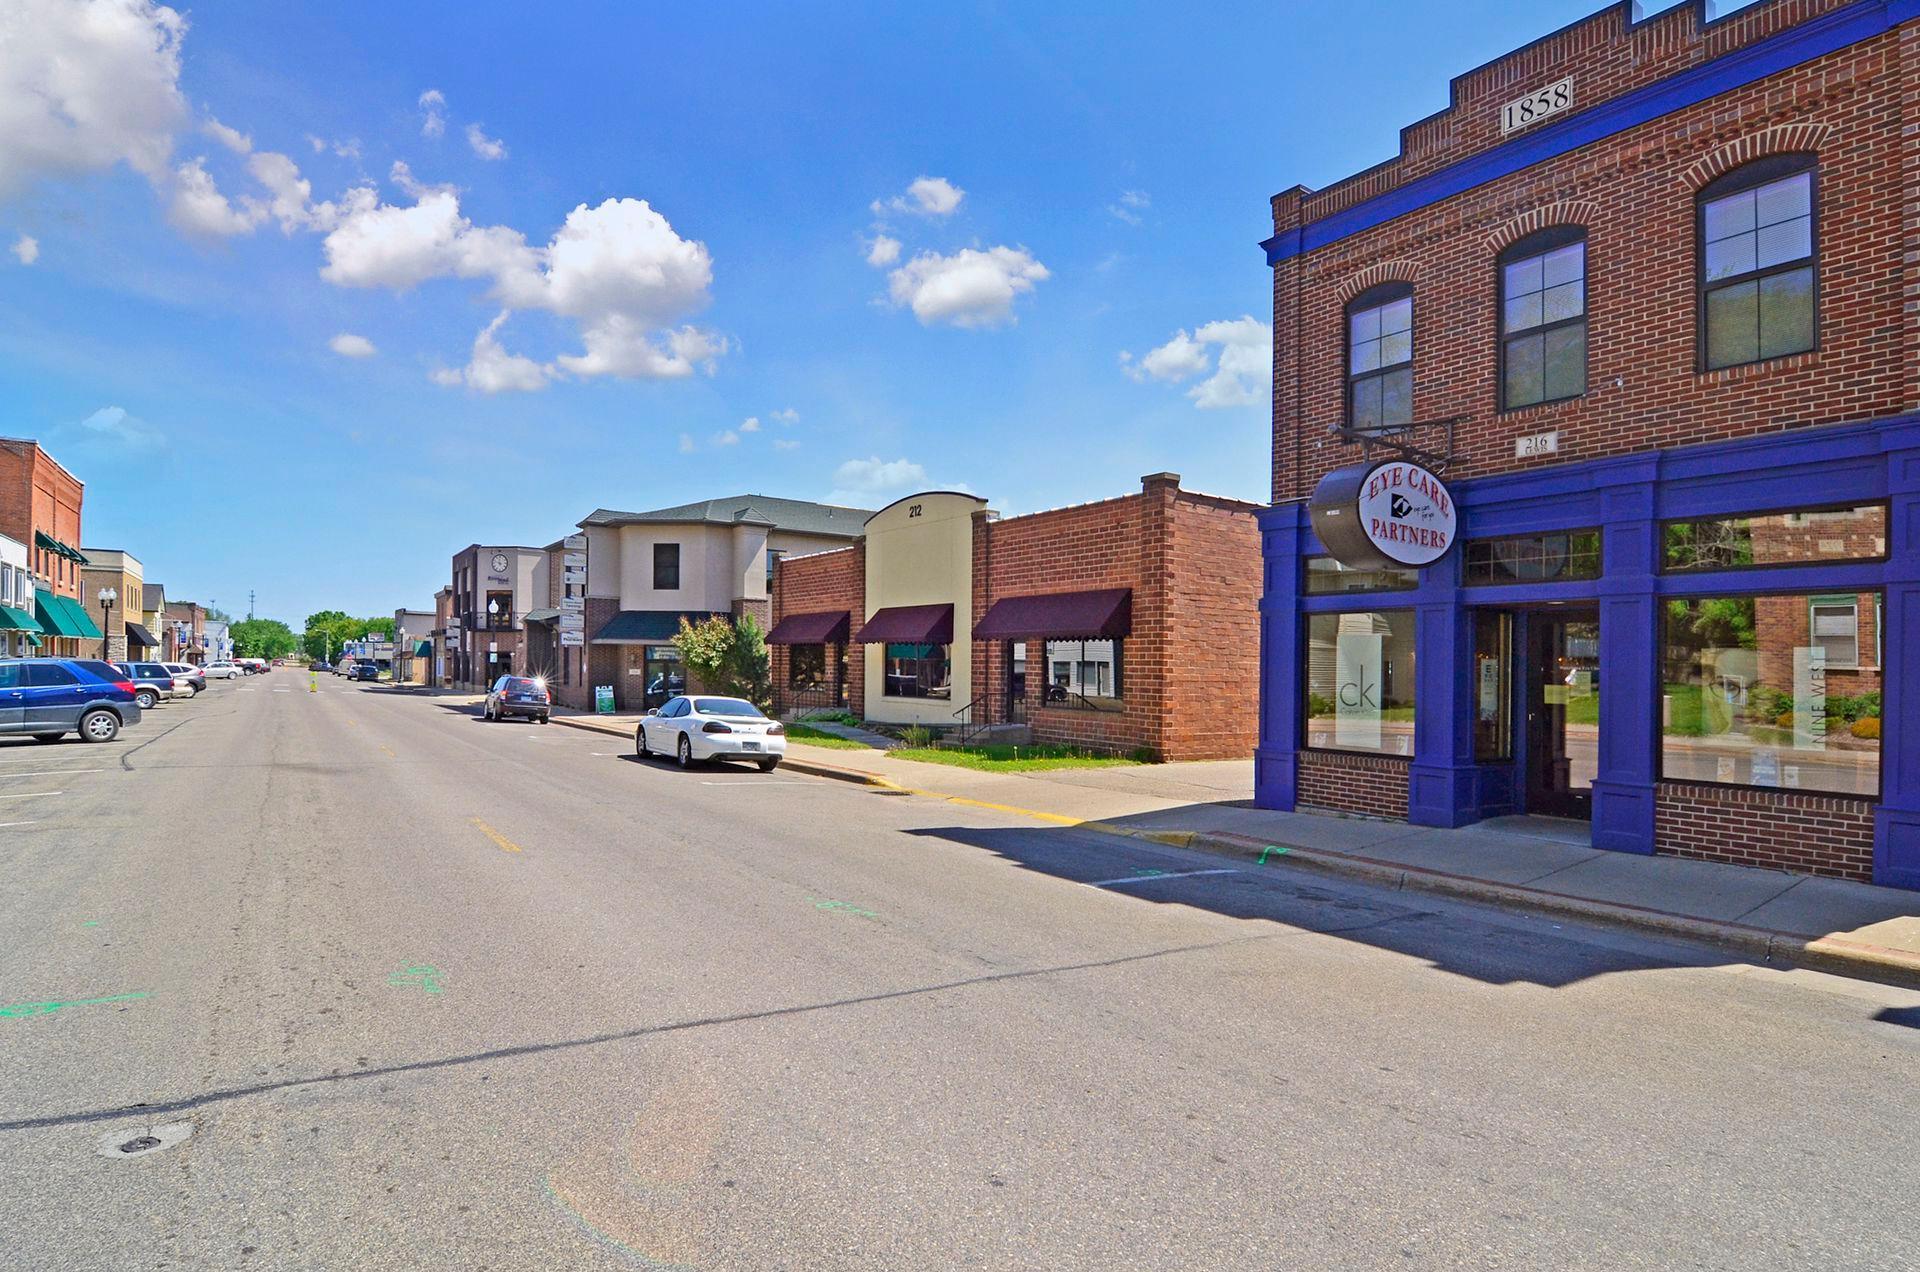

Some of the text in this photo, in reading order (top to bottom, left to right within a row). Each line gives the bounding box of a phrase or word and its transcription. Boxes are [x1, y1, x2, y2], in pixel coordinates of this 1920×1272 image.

[1507, 83, 1568, 129] 1858
[1526, 435, 1548, 448] 216
[909, 504, 922, 518] 212
[1369, 466, 1449, 519] EYE CARE
[1371, 518, 1446, 549] PARTNERS
[1811, 656, 1826, 744] NINE WEST
